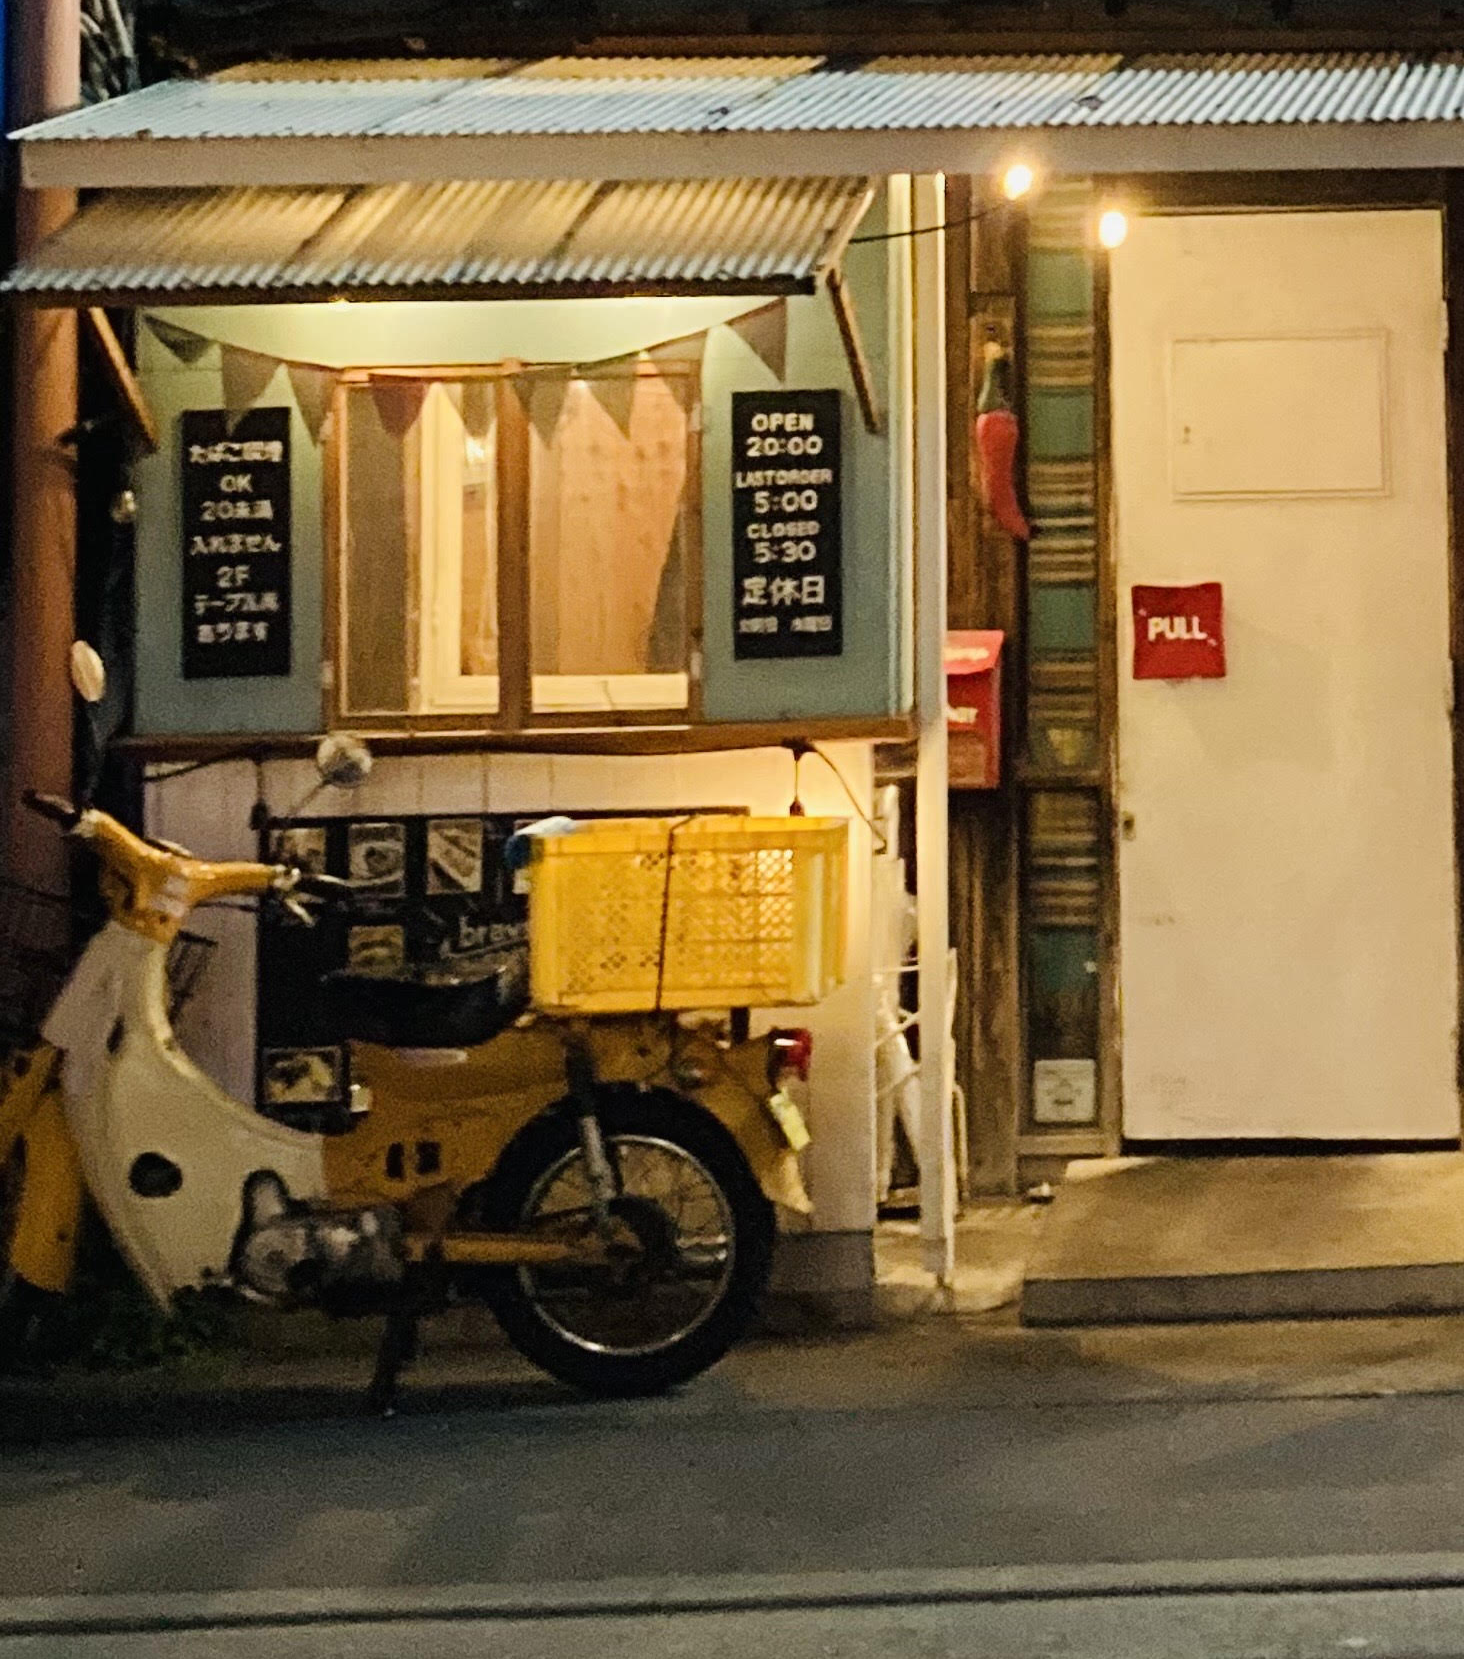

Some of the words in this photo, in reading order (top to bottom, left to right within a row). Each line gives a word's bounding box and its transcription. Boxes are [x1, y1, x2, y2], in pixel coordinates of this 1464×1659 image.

[751, 413, 814, 432] OPEN
[747, 435, 822, 457] 20:00
[220, 474, 252, 492] OK
[755, 490, 818, 513] 5:00
[747, 521, 820, 539] CLOSED
[755, 541, 816, 563] 5:30
[218, 566, 248, 587] 2F
[742, 575, 824, 605] 定休日
[1147, 615, 1208, 642] PULL
